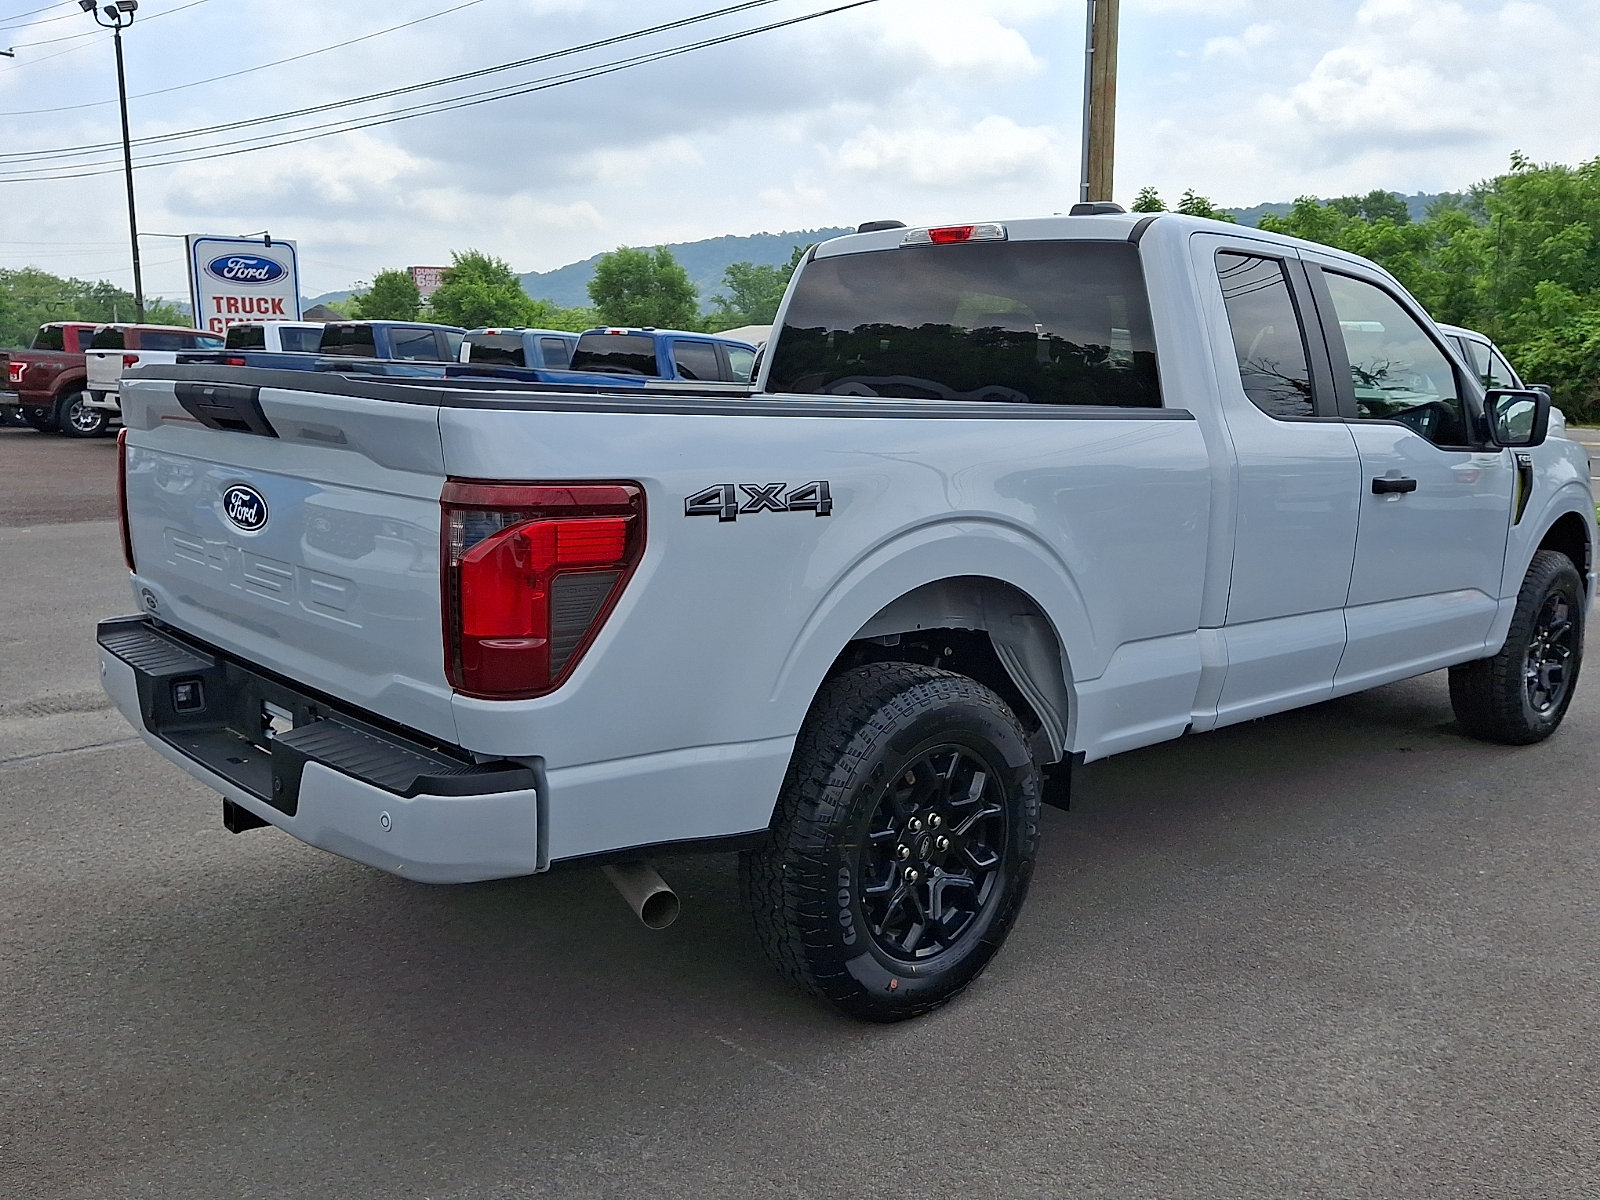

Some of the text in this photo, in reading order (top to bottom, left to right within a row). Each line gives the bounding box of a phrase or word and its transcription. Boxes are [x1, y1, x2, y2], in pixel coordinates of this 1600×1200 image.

[223, 257, 269, 280] Ford
[212, 296, 285, 315] TRUCK
[229, 490, 258, 523] Ford
